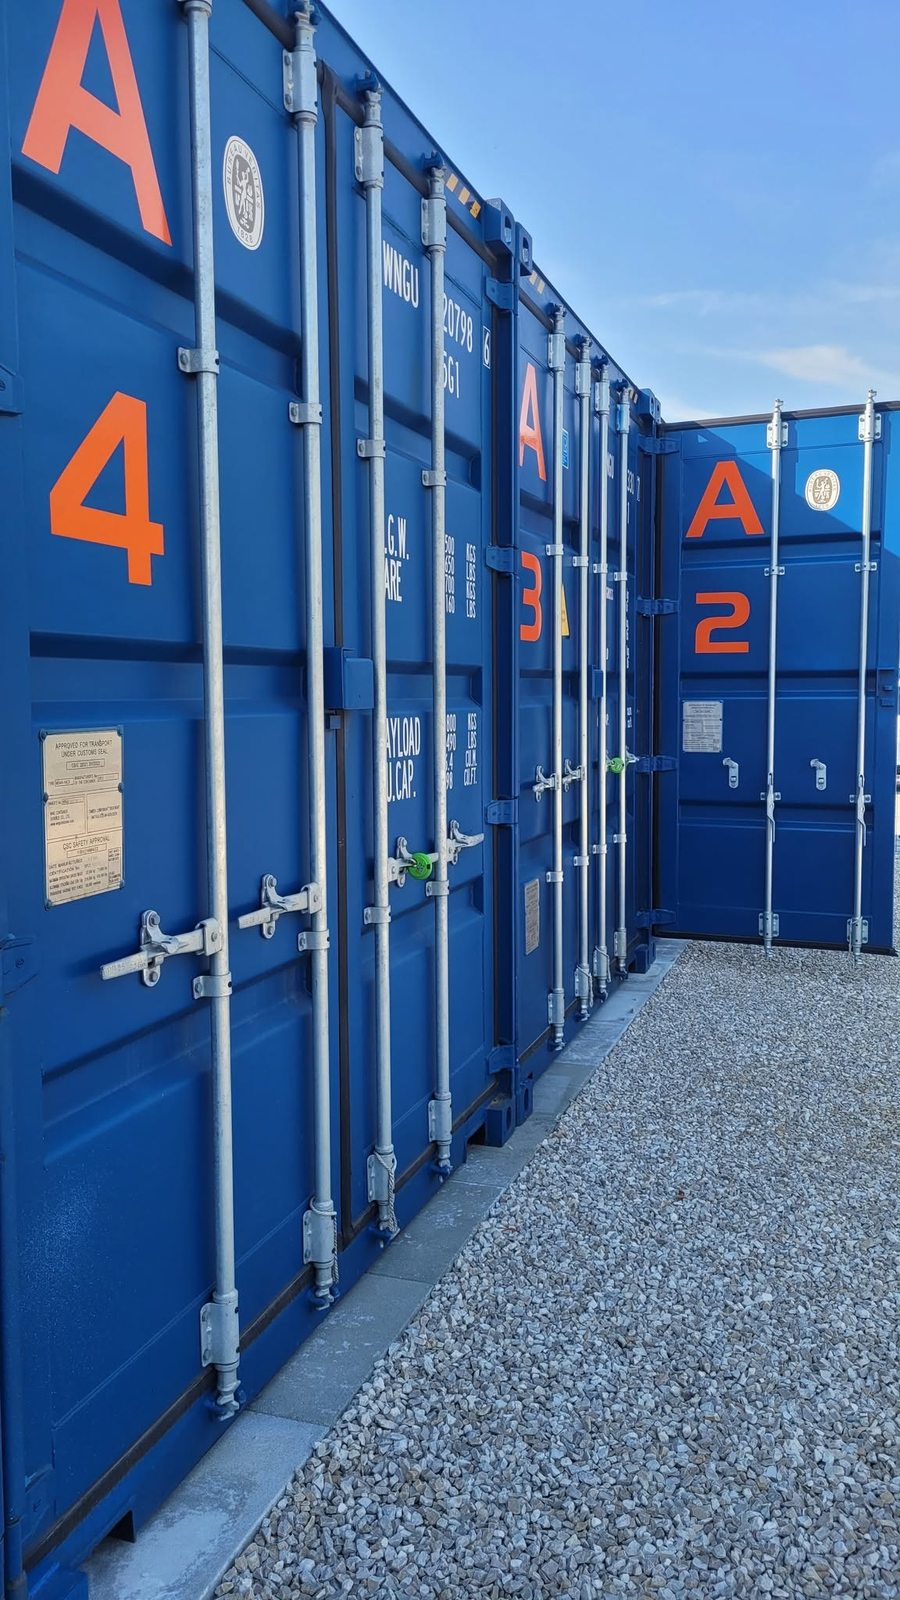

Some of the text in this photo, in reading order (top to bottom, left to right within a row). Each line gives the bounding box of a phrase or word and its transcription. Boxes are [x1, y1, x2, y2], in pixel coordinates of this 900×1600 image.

[21, 0, 172, 246] A
[382, 240, 419, 308] WNGU
[484, 332, 490, 365] 6
[518, 363, 547, 481] A
[50, 391, 164, 586] 4
[685, 460, 765, 538] A
[519, 551, 542, 641] 3
[695, 592, 750, 653] 2
